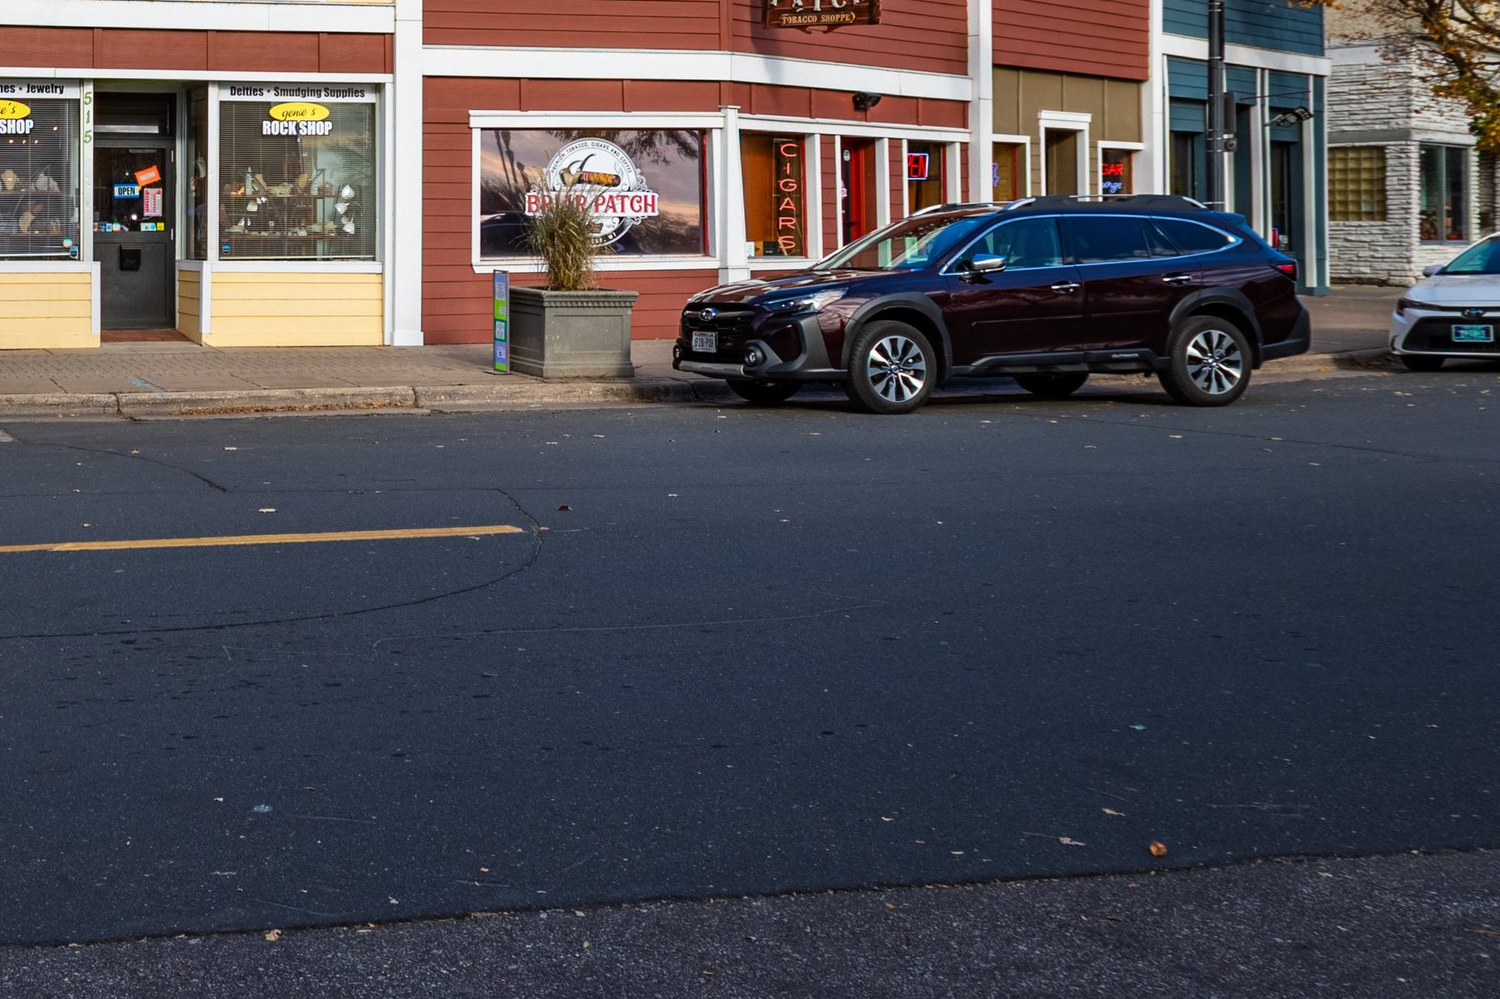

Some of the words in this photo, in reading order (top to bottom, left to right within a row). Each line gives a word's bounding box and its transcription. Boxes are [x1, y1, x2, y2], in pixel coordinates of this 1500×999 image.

[781, 14, 817, 24] TOBACCO
[821, 12, 850, 23] SHOPPE
[26, 83, 64, 94] Jewelry
[230, 86, 264, 96] Deities
[274, 86, 322, 99] Smudging
[324, 87, 365, 99] Supplies
[262, 120, 297, 136] ROCK
[299, 121, 333, 136] SHOP
[591, 142, 610, 151] CIGARS
[908, 154, 926, 177] PEN
[117, 186, 136, 196] OPEN
[778, 143, 798, 250] CIGARS
[527, 194, 587, 213] BRR
[593, 194, 657, 213] PATCH
